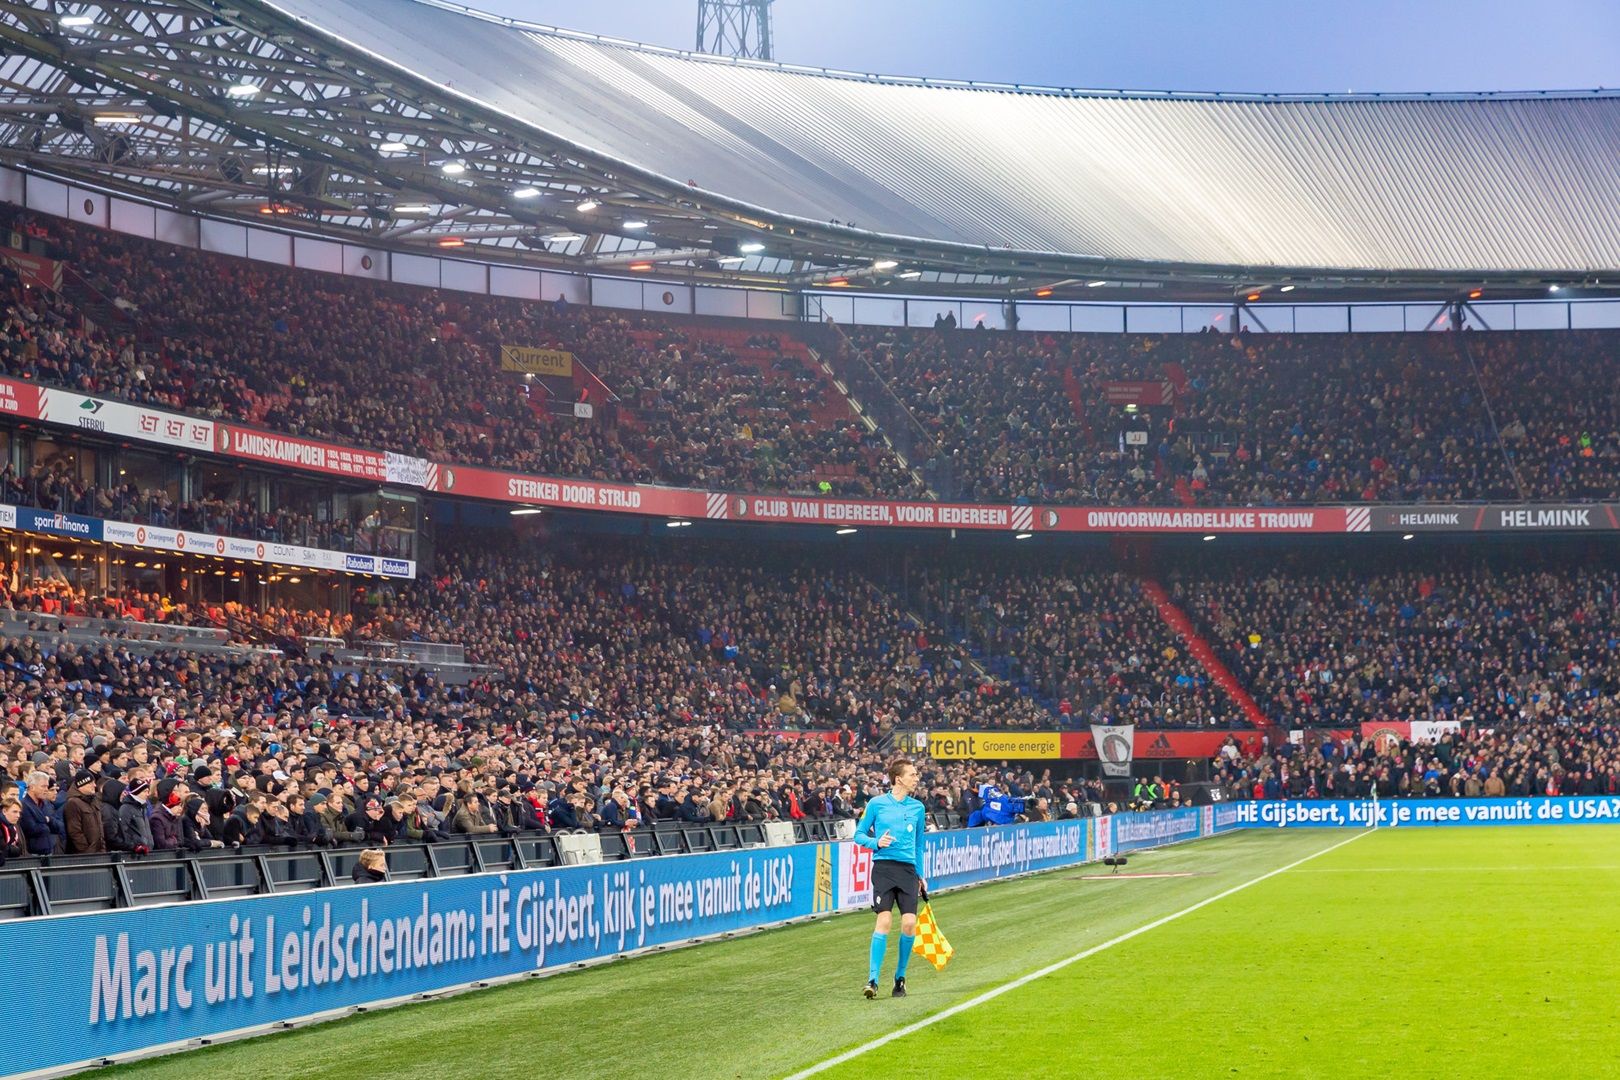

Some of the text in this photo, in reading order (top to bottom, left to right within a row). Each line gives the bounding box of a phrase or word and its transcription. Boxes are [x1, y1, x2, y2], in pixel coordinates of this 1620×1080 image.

[510, 348, 564, 368] Qurrent
[79, 417, 105, 431] STEBRU
[141, 415, 159, 432] RET
[167, 420, 185, 437] RET
[192, 425, 210, 441] RET
[235, 432, 325, 467] LANDSKAMPIOEN
[508, 479, 641, 508] STERKER DOOR STRIJD
[754, 499, 1007, 525] CLUB VAN IEDEREEN, VOOR IEDEREEN
[1088, 511, 1314, 528] ONVOORWAARDELIJKE TROUW
[1400, 513, 1459, 525] HELMINK
[1501, 509, 1590, 526] HELMINK
[149, 531, 175, 544] Oranjegroep
[189, 537, 215, 549] Oranjegroep
[347, 556, 374, 571] Rabobank
[382, 561, 409, 575] Rabobank
[983, 741, 1017, 752] Groene
[1019, 741, 1055, 754] energie
[1237, 801, 1258, 822] HÈ
[1261, 803, 1345, 827] Gijsbert,
[1349, 803, 1387, 827] kijk
[1390, 802, 1410, 827] je
[1415, 805, 1460, 821] mee
[1465, 800, 1532, 820] vanuit
[1537, 799, 1563, 819] de
[1568, 799, 1620, 819] USA?
[851, 844, 873, 892] RET
[89, 854, 794, 1024] Marc uit Leidschendam: HÈ Gijsbert, kijk je mee vanuit de USA?
